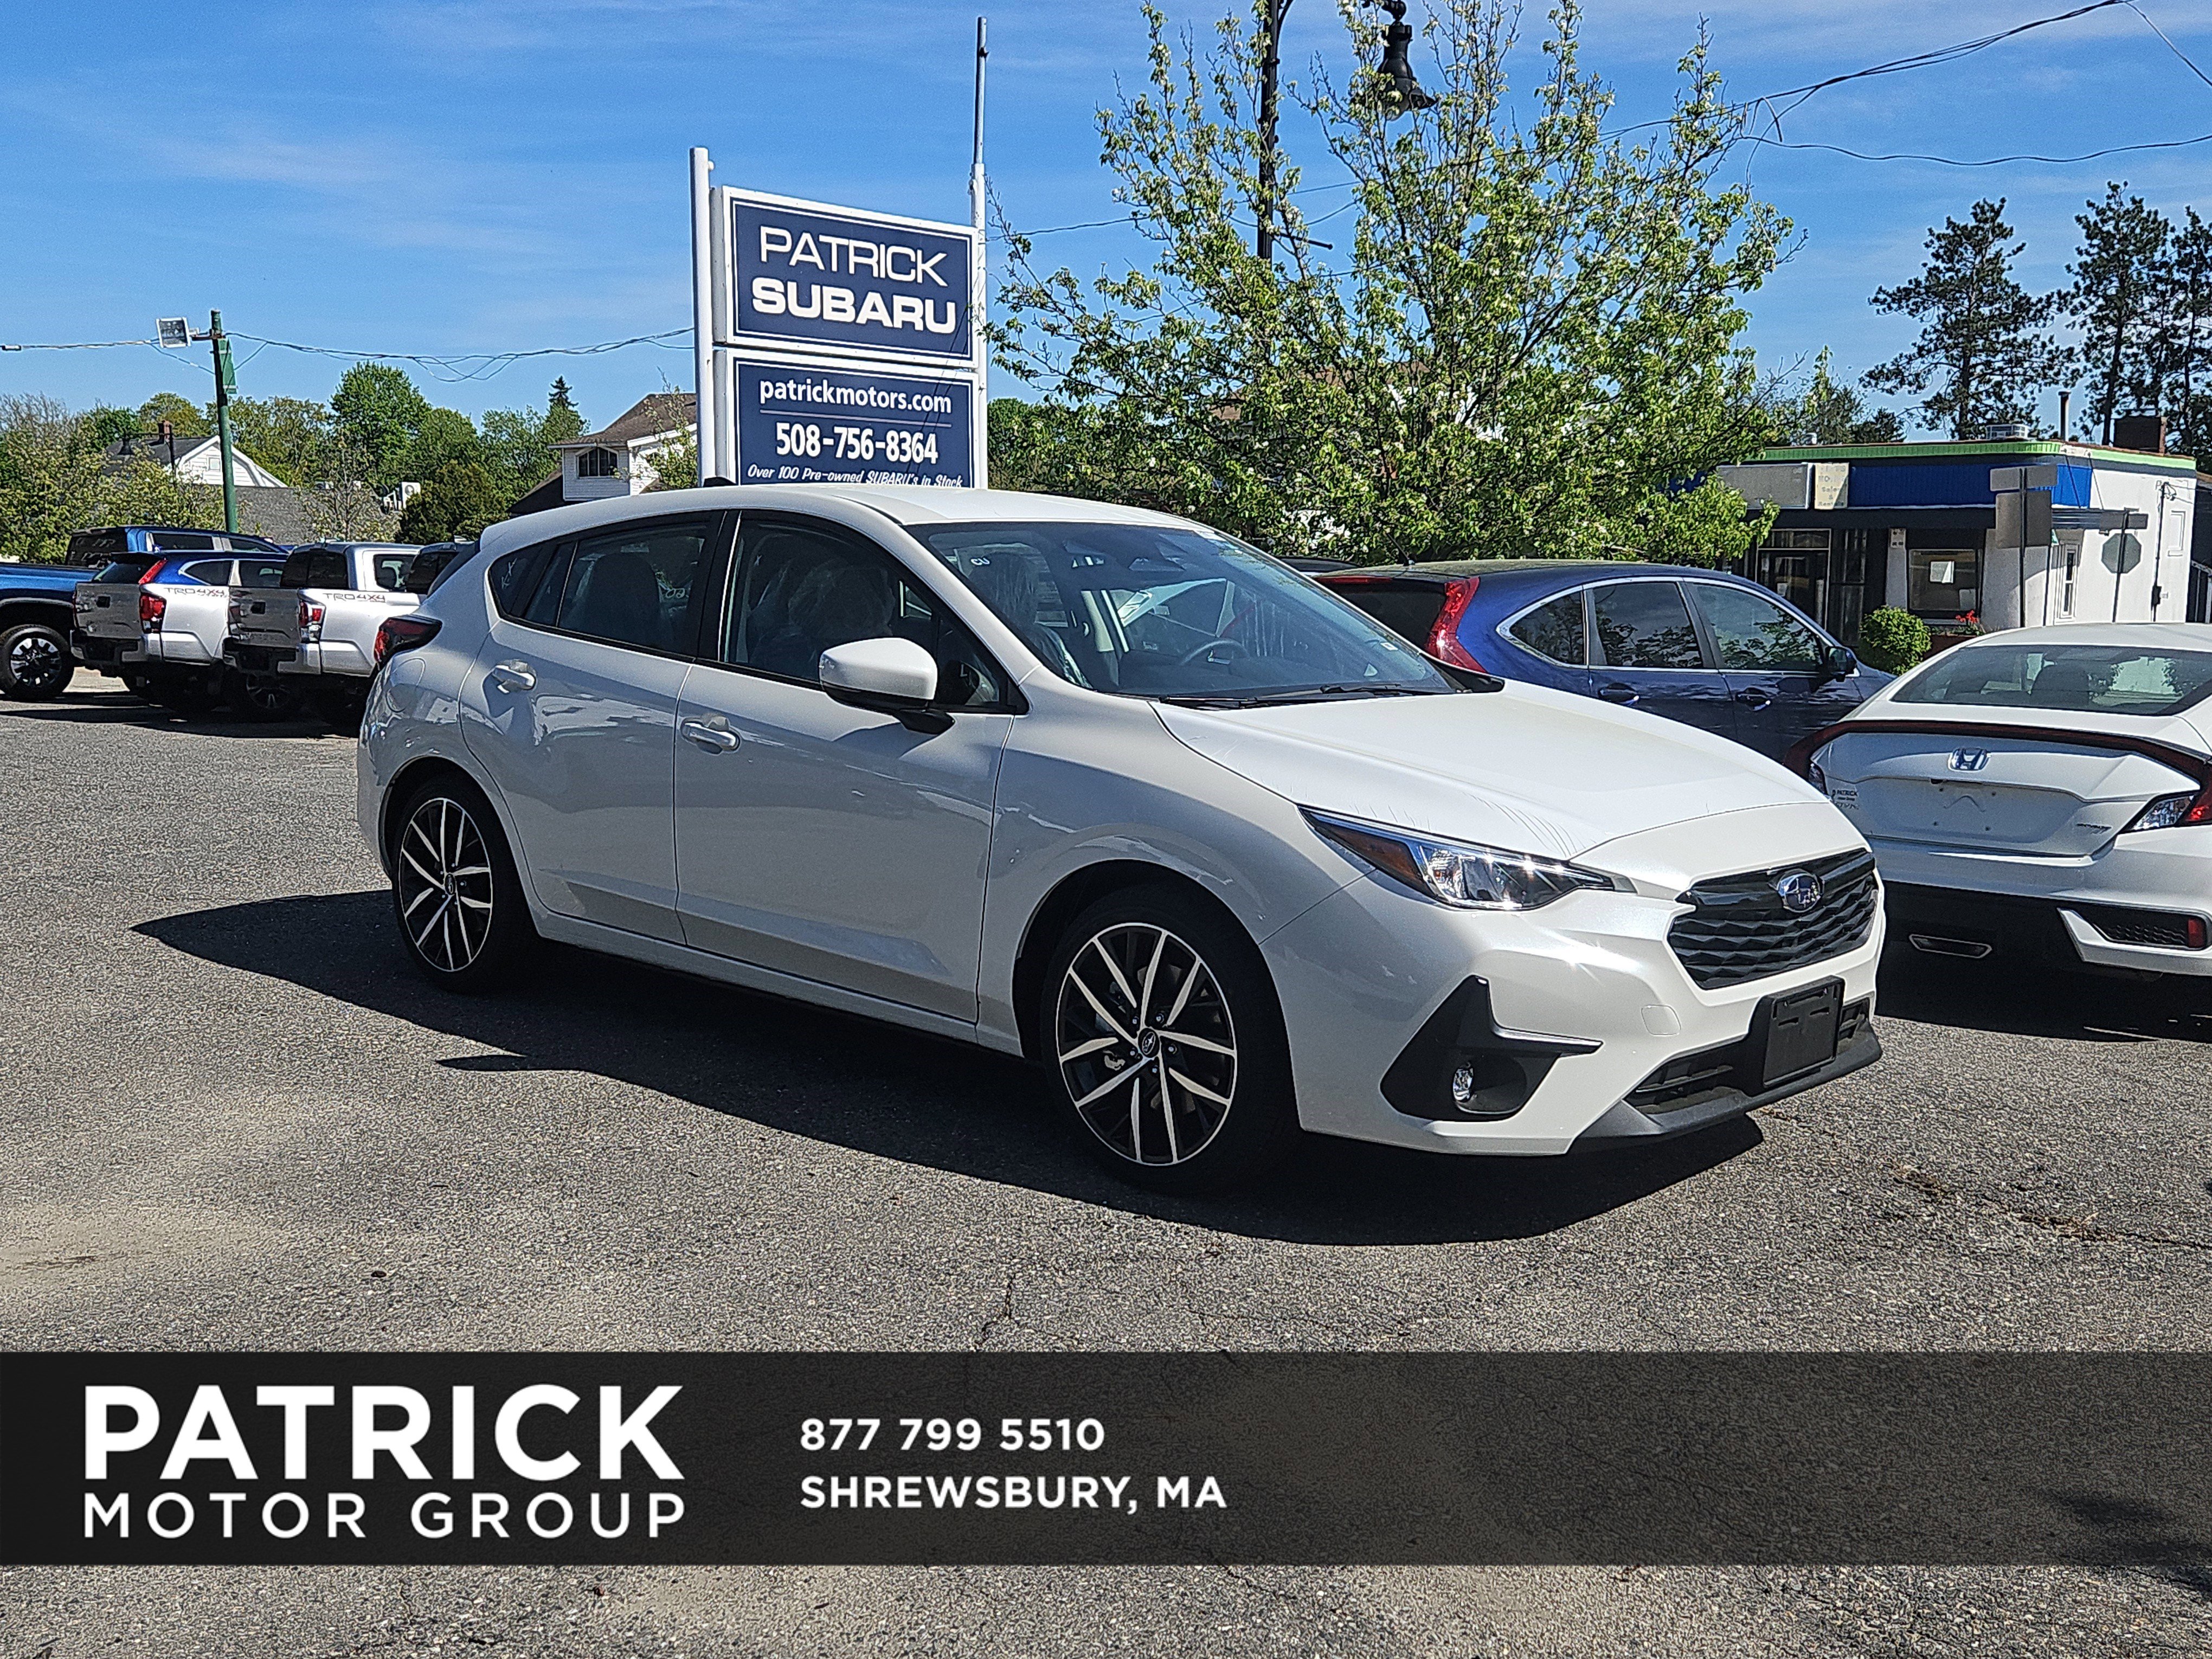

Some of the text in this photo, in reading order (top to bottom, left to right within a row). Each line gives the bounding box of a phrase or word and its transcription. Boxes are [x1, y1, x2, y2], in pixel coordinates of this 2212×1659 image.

[760, 226, 948, 286] PATRICK
[753, 277, 956, 333] SUBARU
[760, 379, 951, 413] patrickmotors.com
[776, 422, 938, 464] 508-756-8364
[748, 464, 963, 487] Over 100 Pre-owned SUBARU's in Stock
